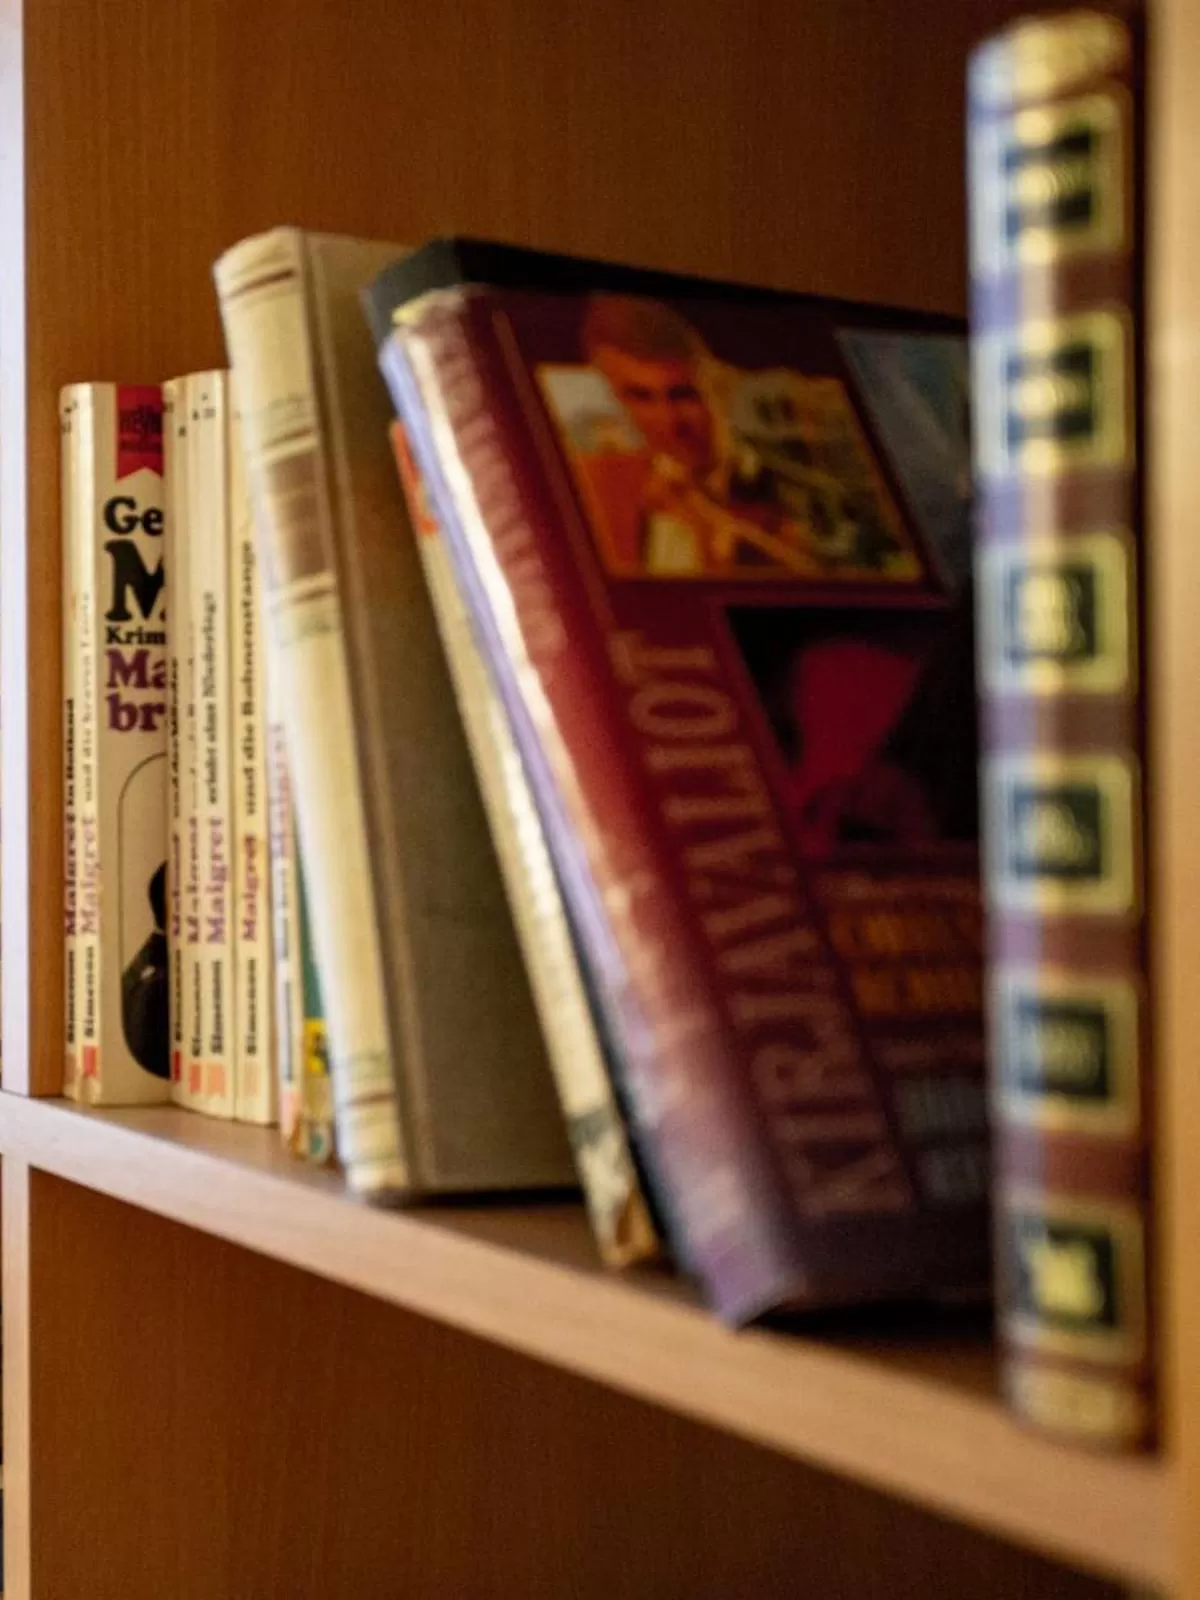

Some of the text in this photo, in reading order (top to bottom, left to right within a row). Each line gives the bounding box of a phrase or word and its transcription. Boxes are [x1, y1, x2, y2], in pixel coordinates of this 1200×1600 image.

[104, 497, 165, 535] Ge
[105, 626, 166, 646] Krim
[105, 650, 166, 690] Ma
[105, 694, 166, 733] br
[241, 726, 254, 761] die
[246, 767, 256, 815] und
[81, 817, 100, 935] Maigret
[206, 817, 228, 944] Maigret
[243, 835, 261, 942] Maigret
